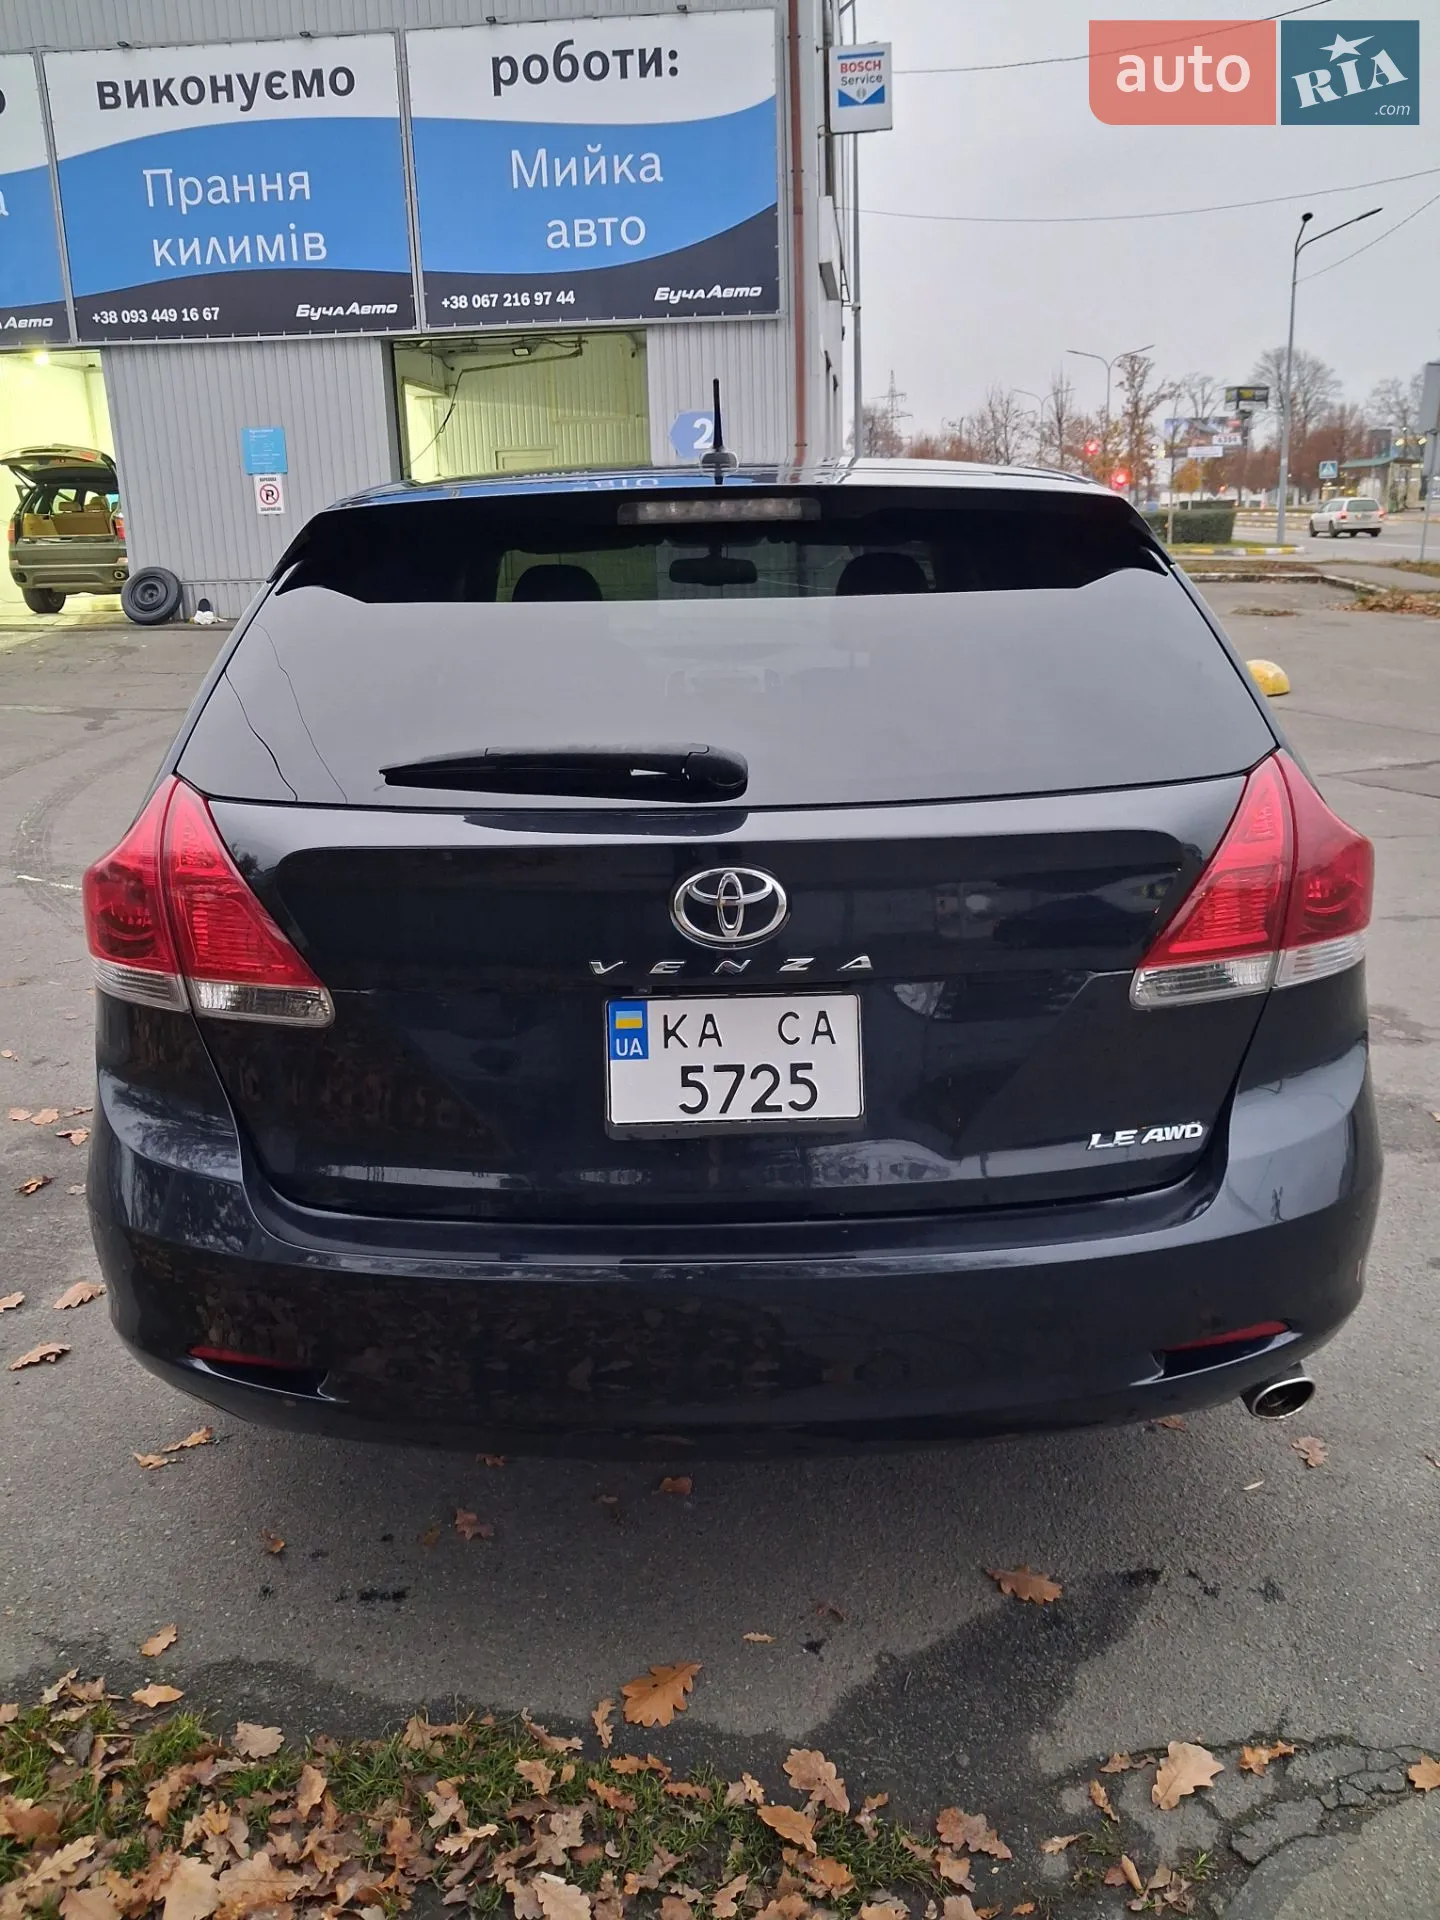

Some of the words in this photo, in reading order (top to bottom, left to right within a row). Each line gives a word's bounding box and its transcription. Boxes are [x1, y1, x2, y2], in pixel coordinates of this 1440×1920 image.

[491, 39, 679, 97] роботи:
[840, 60, 882, 74] BOSCH
[841, 74, 883, 87] Service
[96, 66, 356, 112] виконуємо
[511, 144, 664, 190] Мийка
[143, 168, 311, 215] Прання
[153, 223, 328, 267] килимів
[546, 215, 647, 250] авто
[92, 311, 119, 324] +38
[121, 309, 148, 323] 093
[151, 308, 178, 322] 449
[181, 307, 200, 321] 16
[202, 306, 220, 321] 67
[441, 295, 469, 309] +38
[471, 293, 499, 308] 067
[503, 292, 531, 307] 216
[534, 291, 553, 306] 97
[556, 290, 576, 304] 44
[692, 418, 715, 449] 2
[588, 955, 874, 976] VENZA
[662, 1013, 723, 1049] KA
[777, 1010, 838, 1045] CA
[615, 1038, 643, 1057] UA
[678, 1062, 819, 1115] 5725
[1087, 1129, 1138, 1150] LE
[1140, 1123, 1204, 1145] AWD
